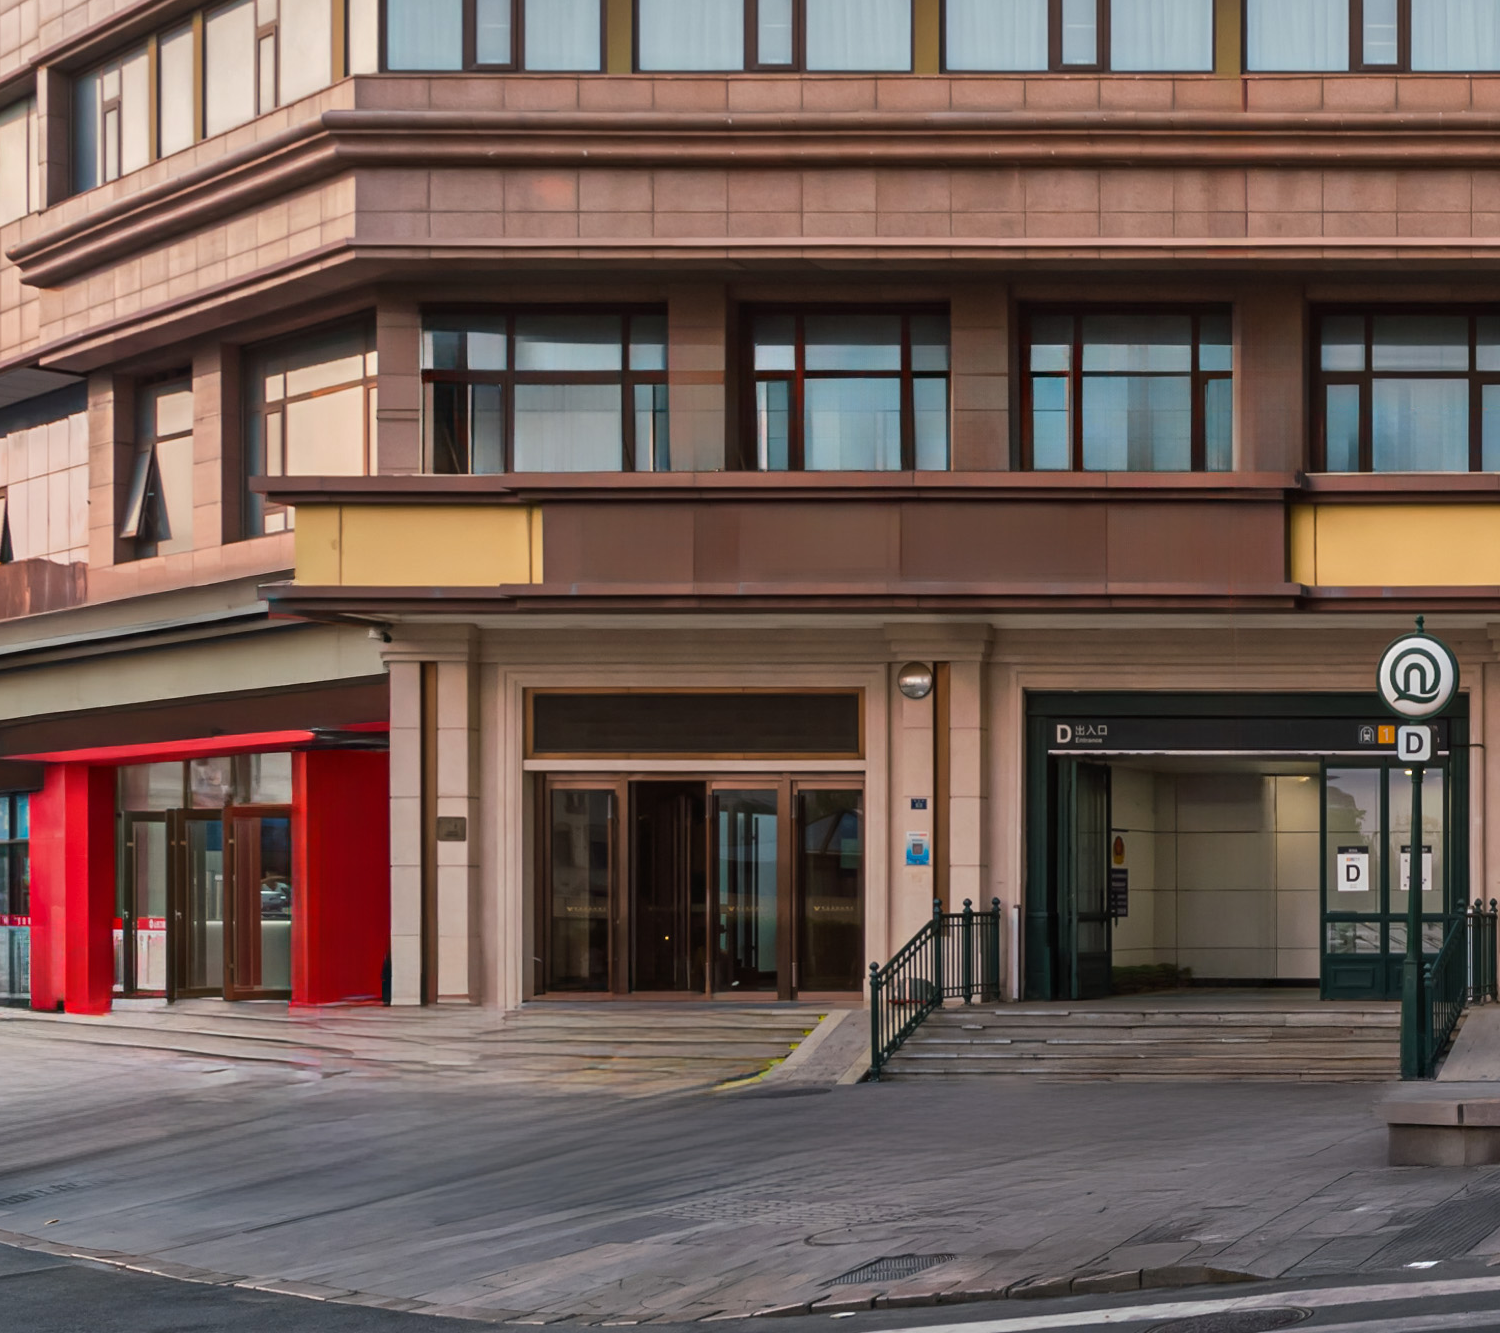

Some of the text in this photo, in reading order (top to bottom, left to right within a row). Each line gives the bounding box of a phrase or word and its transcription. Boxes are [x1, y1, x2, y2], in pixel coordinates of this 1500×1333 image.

[1056, 724, 1108, 743] D 出入口
[1406, 732, 1424, 753] D
[1346, 864, 1361, 882] D
